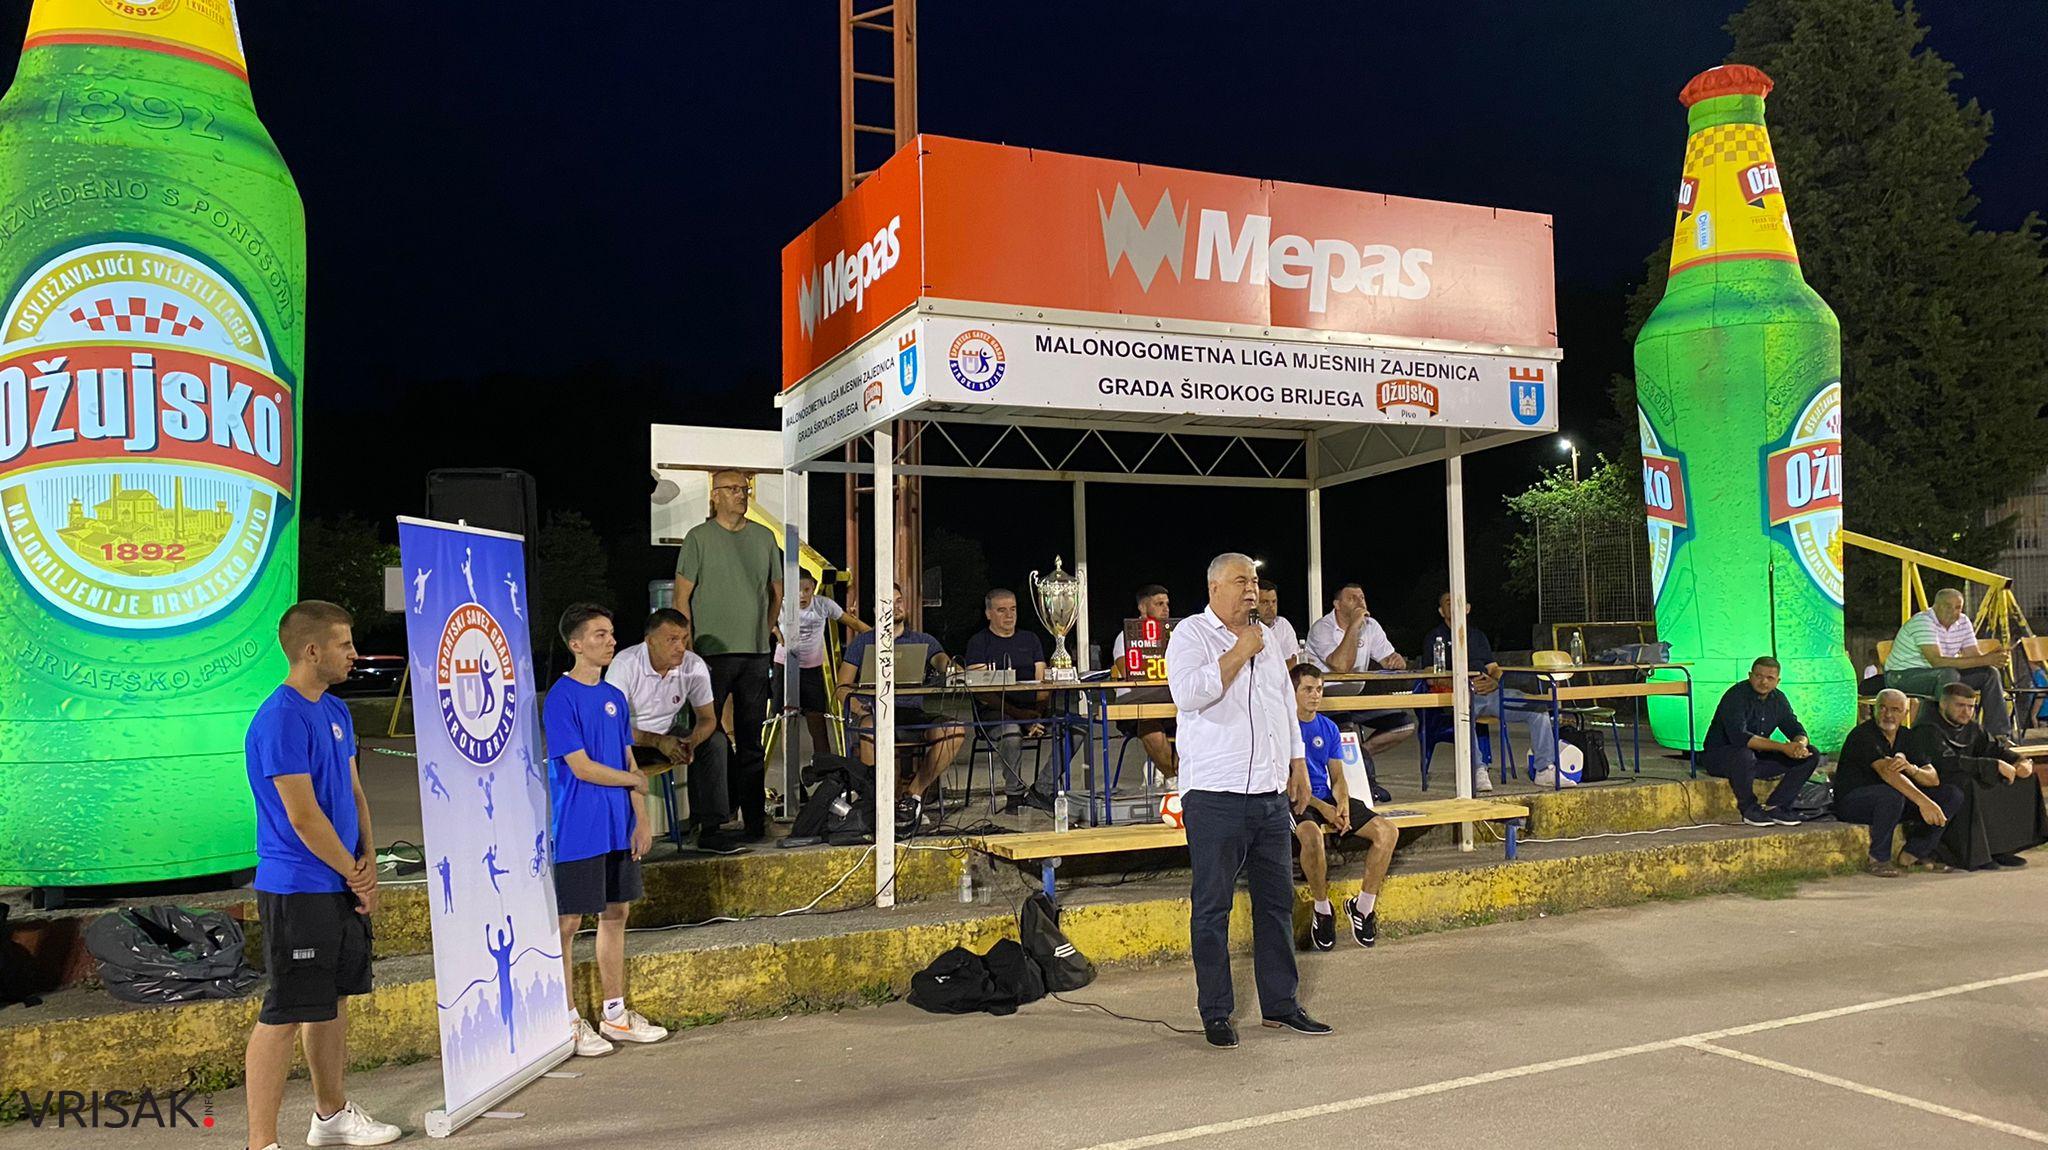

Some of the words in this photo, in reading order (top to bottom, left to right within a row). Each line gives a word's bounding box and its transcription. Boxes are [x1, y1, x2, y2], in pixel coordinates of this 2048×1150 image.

[116, 2, 159, 16] 1892
[44, 89, 224, 141] 1892
[1746, 164, 1780, 195] Ožu
[161, 188, 180, 207] S
[190, 197, 290, 316] PONOSOM
[823, 215, 900, 319] Mepas
[1194, 209, 1433, 313] Mepas
[18, 253, 134, 333] OSVJEŽAVAJUĆI
[141, 258, 219, 303] SVIJETLI
[214, 298, 252, 347] LAGER
[863, 356, 896, 384] ZAJEDNICA
[1035, 334, 1236, 364] MALONOGOMETNA
[1241, 349, 1287, 368] LIGA
[1293, 352, 1375, 374] MJESNIH
[1380, 358, 1480, 382] ZAJEDNICA
[0, 353, 281, 463] Ožujsko
[1099, 377, 1174, 398] GRADA
[1180, 378, 1274, 402] ŠIROKOG
[1281, 387, 1364, 408] BRIJEGA
[1381, 381, 1434, 406] Ožujsko
[1786, 447, 1842, 508] Ožu
[8, 502, 140, 615] NAJOMILJENIJE
[152, 555, 247, 615] HRVATSKO
[242, 508, 267, 553] PIVO
[100, 543, 186, 561] 1892
[466, 609, 490, 633] SAVEZ
[490, 627, 512, 677] GRADA
[1131, 640, 1158, 648] HOME
[1146, 620, 1157, 640] 0
[18, 640, 190, 692] HRVATSKO
[201, 638, 258, 682] PIVO
[1129, 649, 1140, 669] 0
[1147, 658, 1168, 679] 20
[486, 692, 515, 758] BRIJEG
